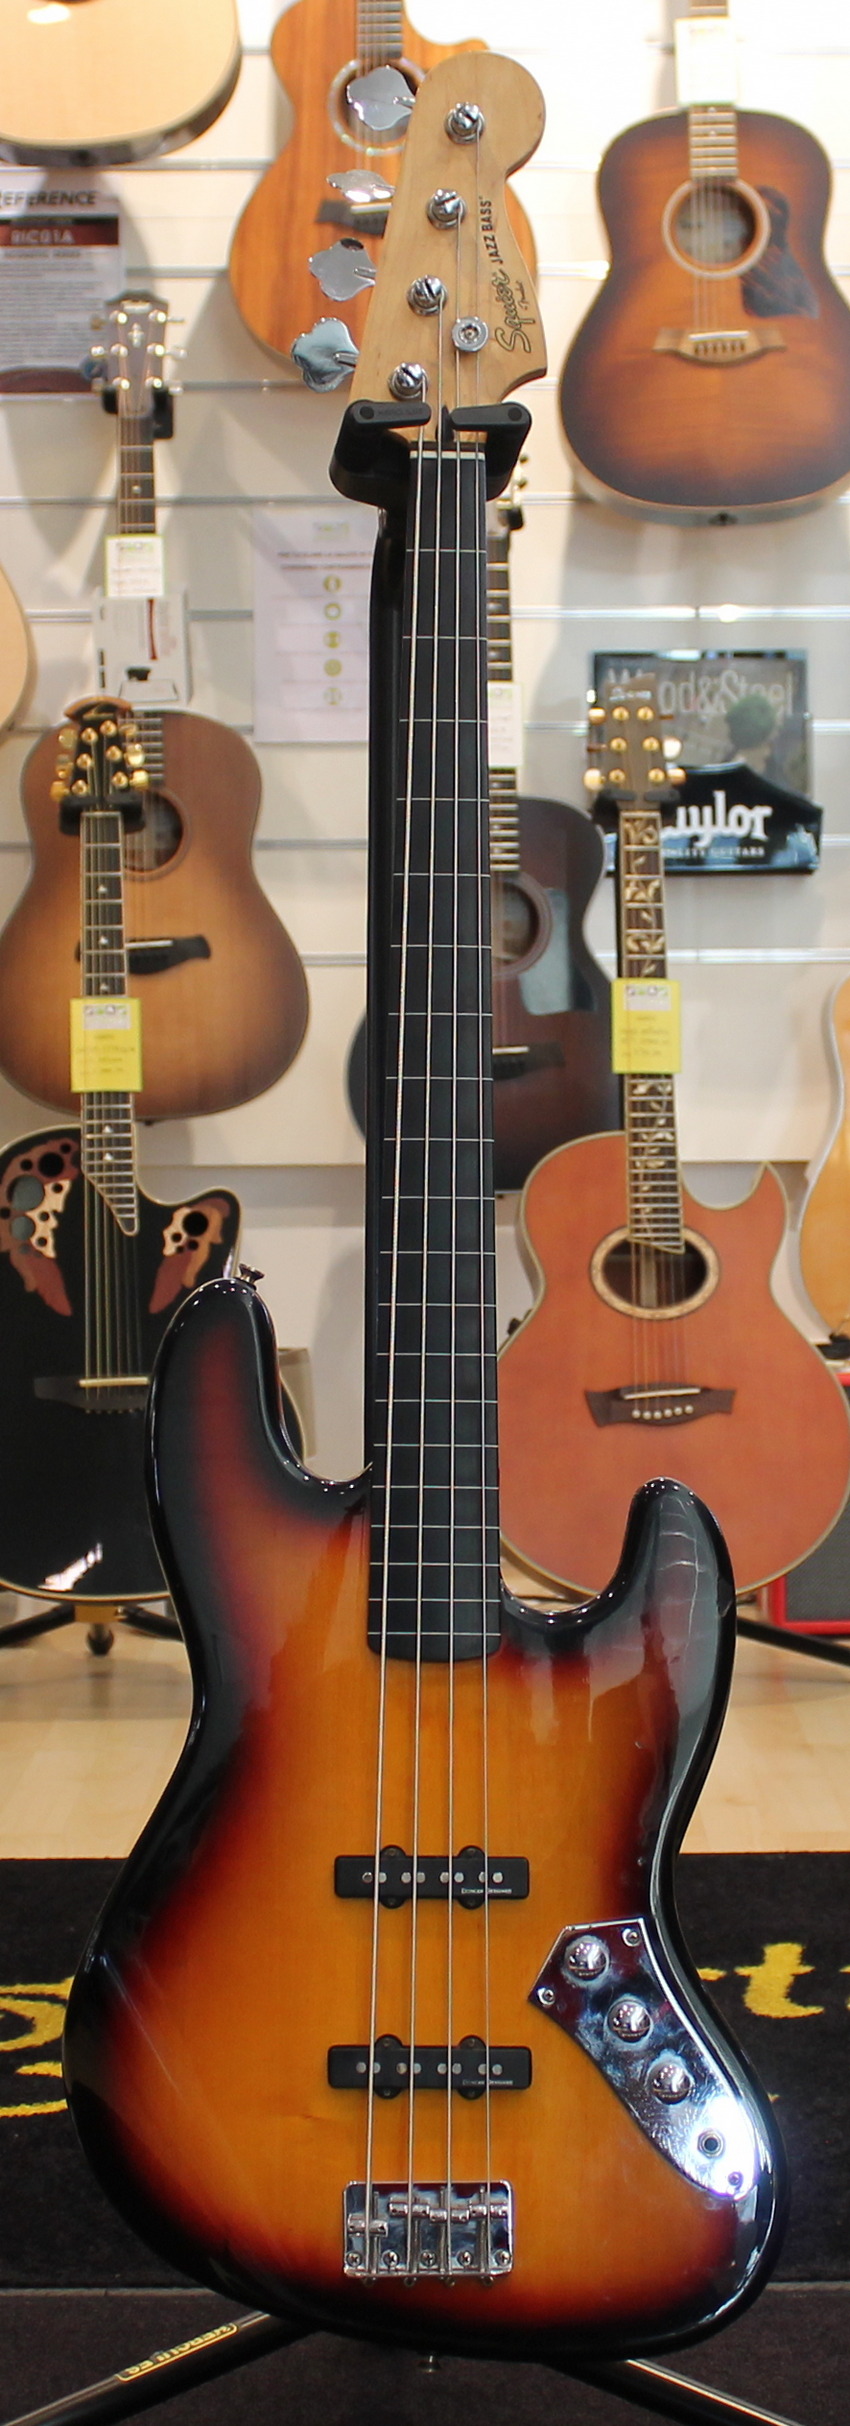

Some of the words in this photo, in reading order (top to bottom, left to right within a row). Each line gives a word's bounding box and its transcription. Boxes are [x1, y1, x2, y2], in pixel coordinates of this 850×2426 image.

[0, 190, 96, 206] EFERENCE
[479, 198, 494, 232] BASS
[484, 234, 504, 265] JAZZ
[492, 270, 536, 353] Squier
[661, 790, 773, 847] aylor
